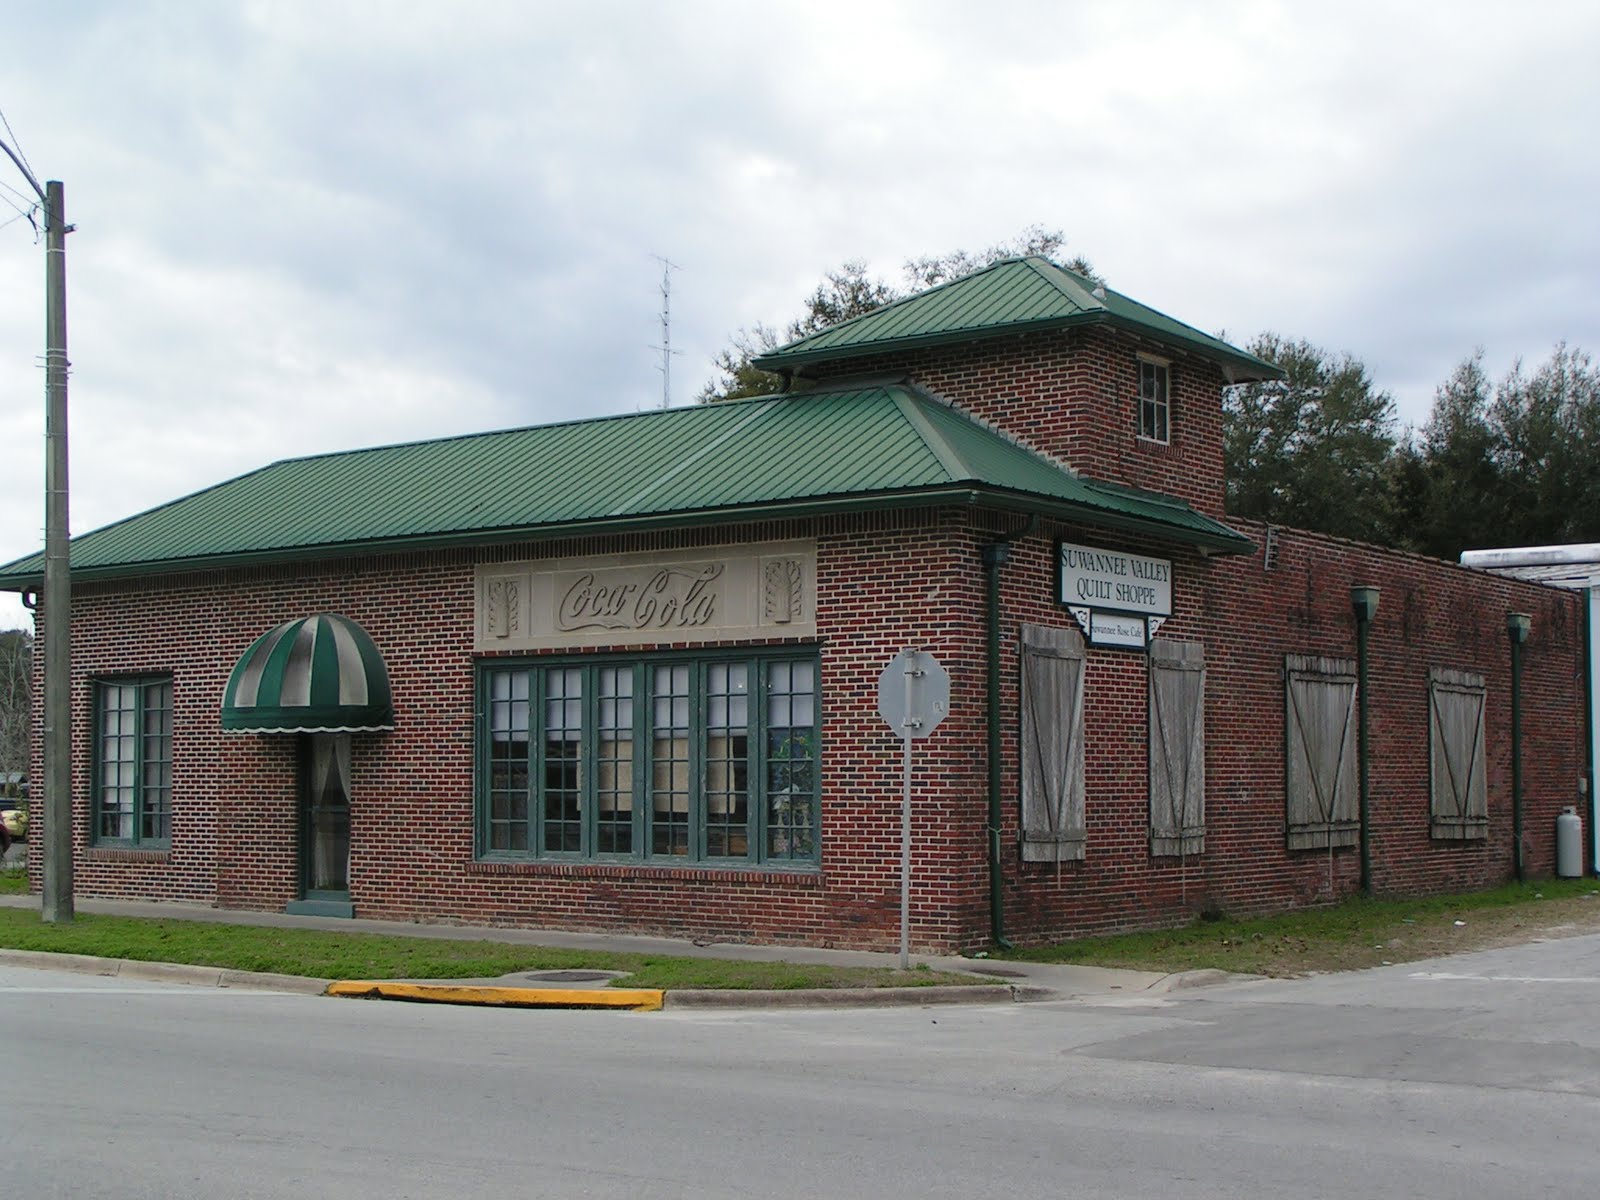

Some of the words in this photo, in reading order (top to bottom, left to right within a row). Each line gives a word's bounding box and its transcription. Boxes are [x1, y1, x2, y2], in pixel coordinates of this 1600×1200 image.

[1061, 548, 1127, 576] SUWANNEE
[1131, 559, 1169, 582] VALLEY
[1077, 577, 1112, 600] QUILT
[1115, 584, 1155, 605] SHOPPE
